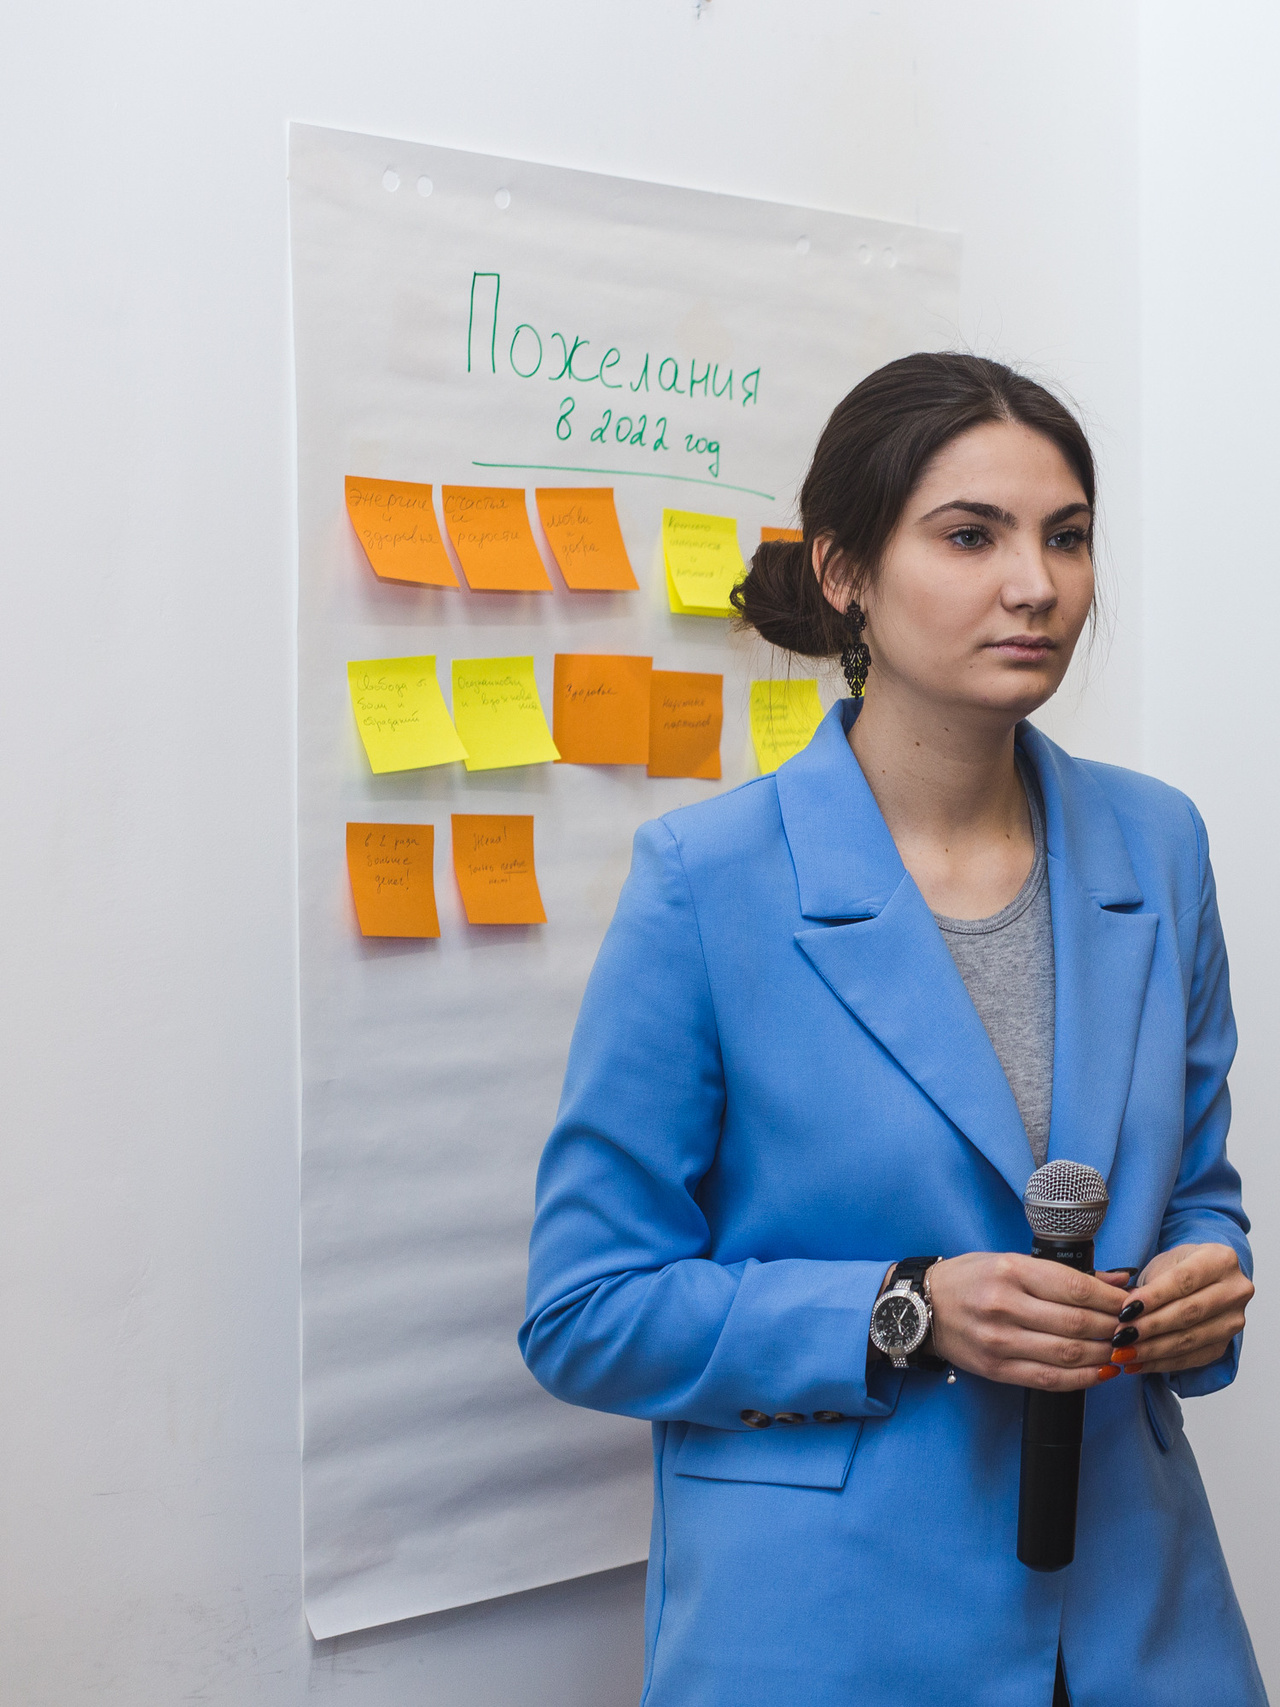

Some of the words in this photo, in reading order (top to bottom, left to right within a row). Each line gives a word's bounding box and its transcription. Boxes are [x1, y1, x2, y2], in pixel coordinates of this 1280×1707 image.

[468, 271, 761, 407] Пожелания
[590, 409, 670, 452] 2022
[685, 434, 720, 479] год
[349, 488, 430, 512] Энергии
[382, 513, 392, 523] и
[1056, 1251, 1075, 1259] SM58
